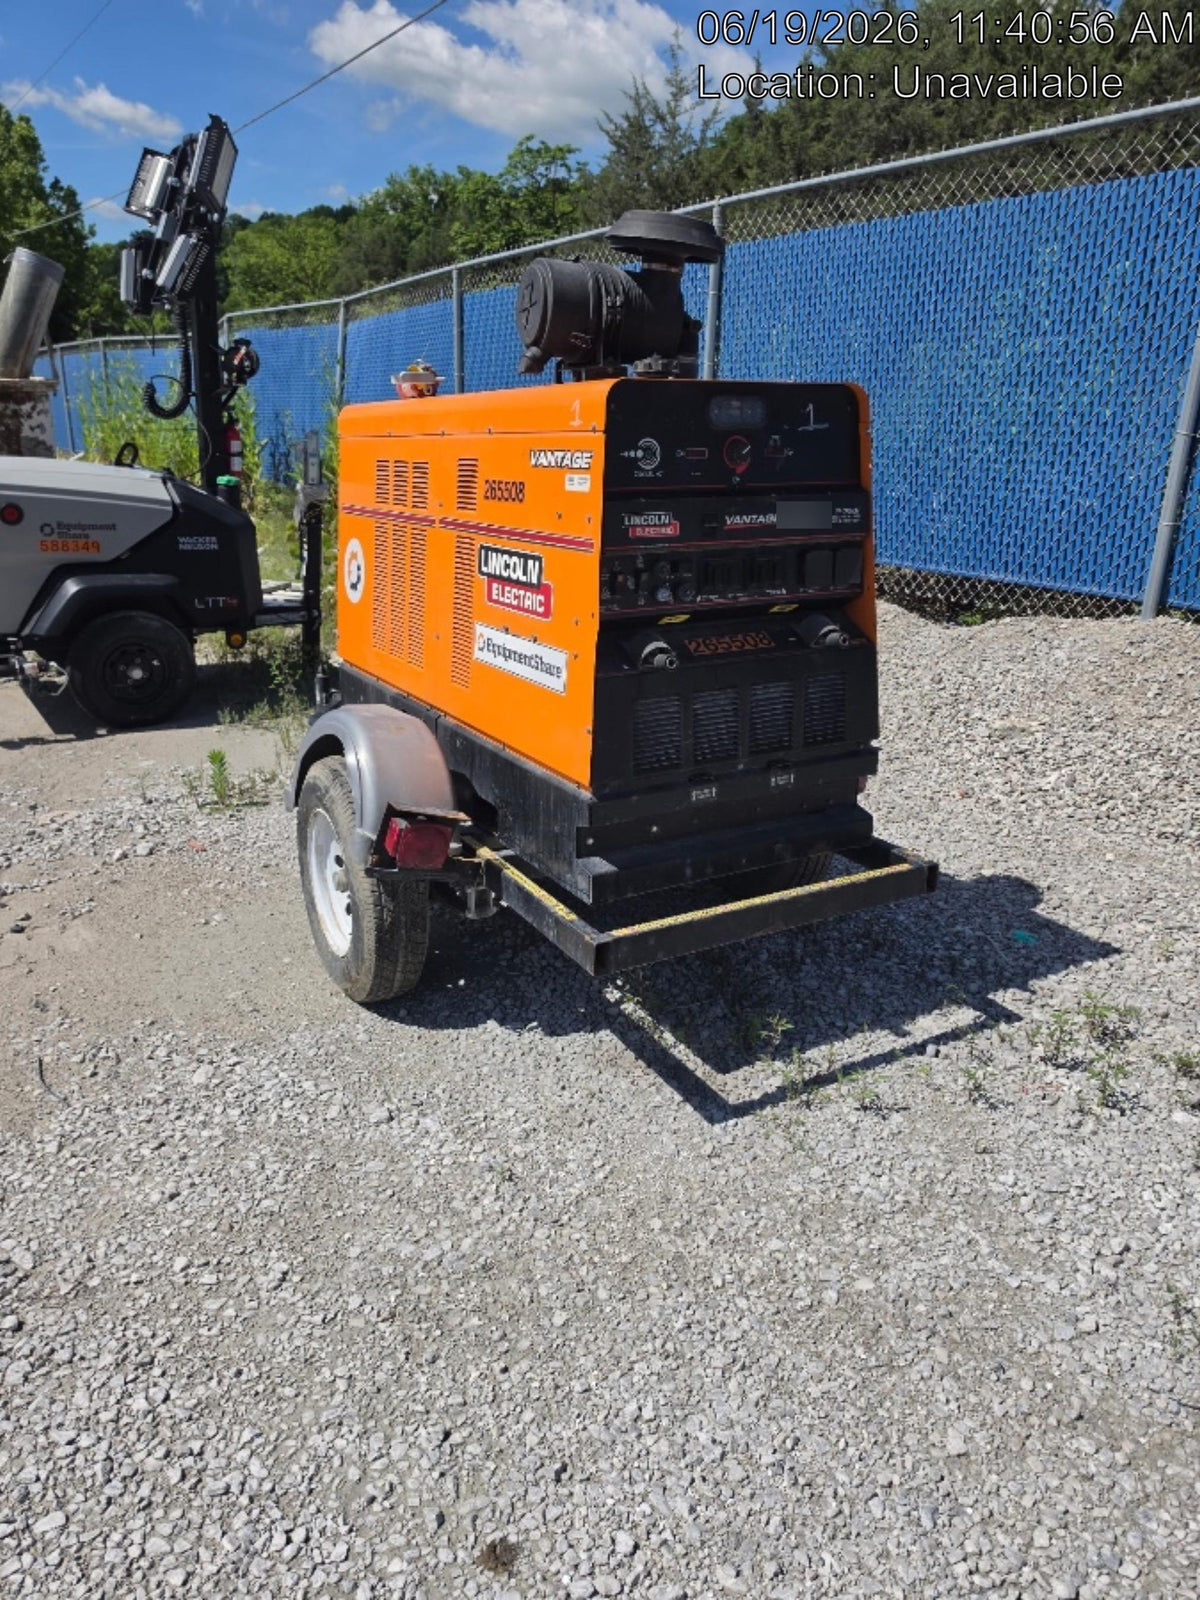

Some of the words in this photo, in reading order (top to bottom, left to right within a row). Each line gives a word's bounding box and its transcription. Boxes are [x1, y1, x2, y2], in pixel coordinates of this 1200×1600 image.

[530, 450, 593, 469] VANTAGE
[484, 480, 525, 503] 265508
[56, 521, 116, 532] Equipment
[625, 514, 670, 526] LINCOLN
[480, 549, 540, 585] LINCOLN
[491, 583, 545, 613] ELECTRIC
[686, 632, 772, 655] 265508
[485, 636, 564, 680] EquipmentShare
